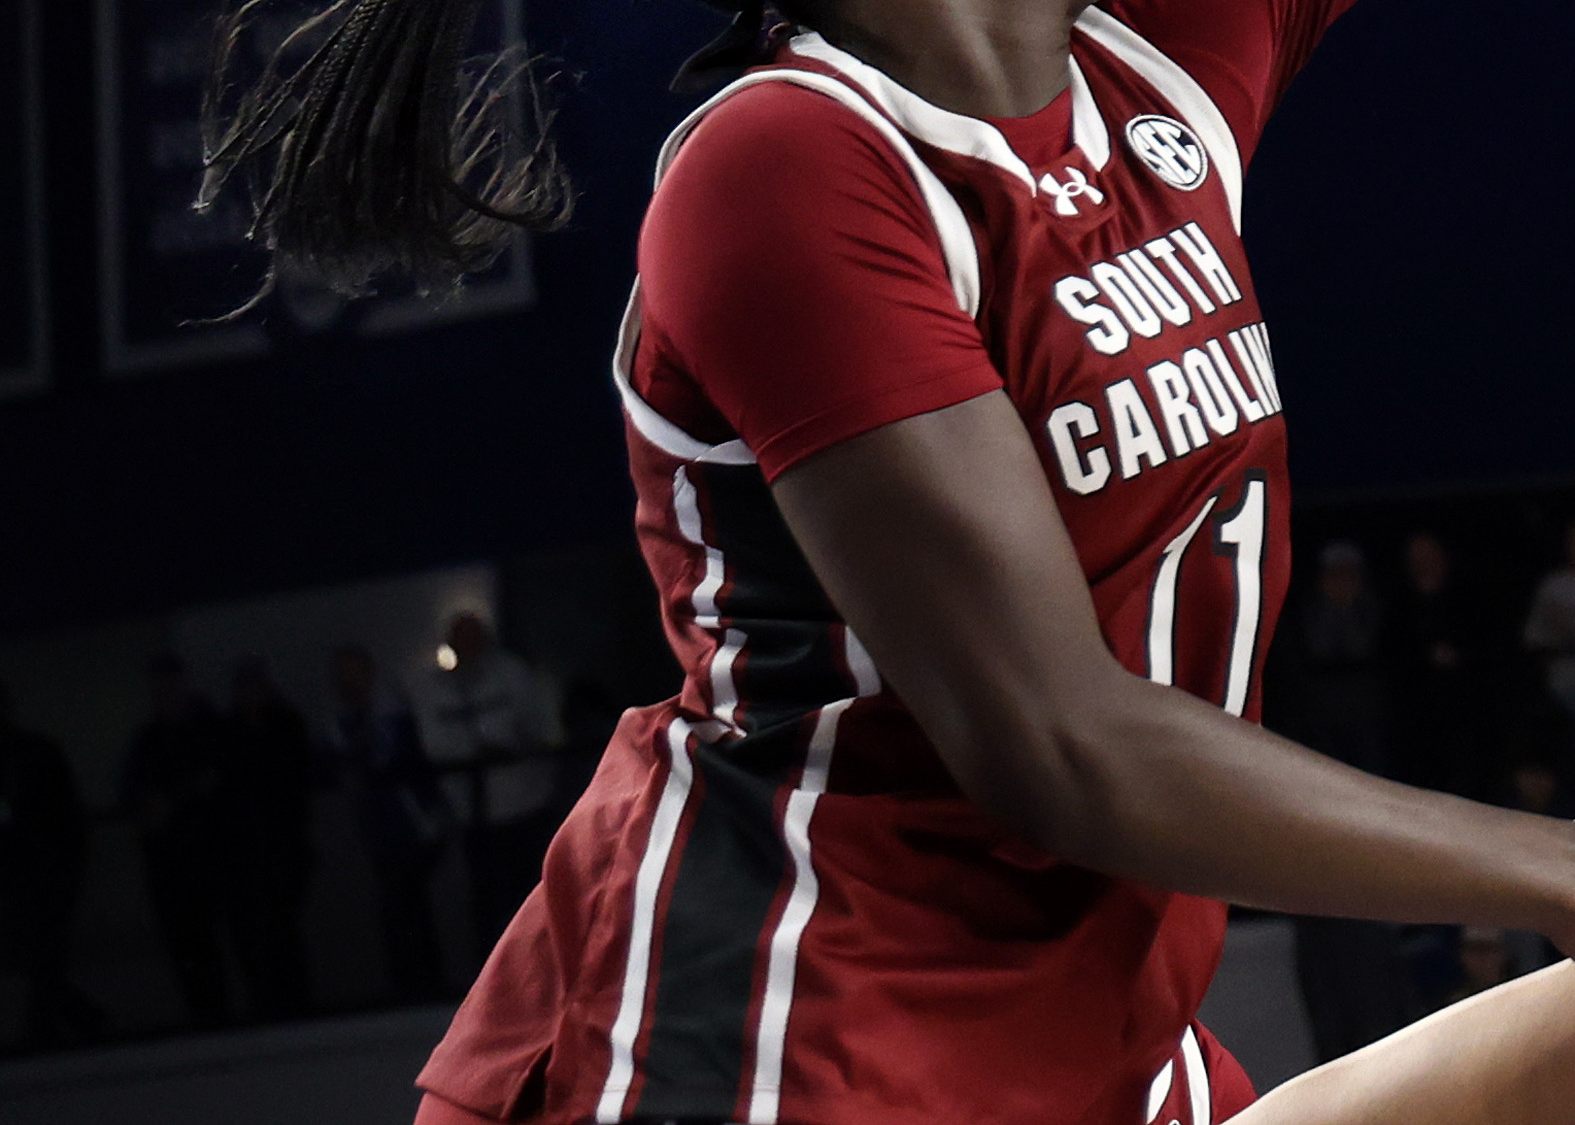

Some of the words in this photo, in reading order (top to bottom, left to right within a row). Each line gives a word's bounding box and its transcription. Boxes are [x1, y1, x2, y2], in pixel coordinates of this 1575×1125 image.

[1130, 119, 1203, 187] SEC
[1053, 219, 1243, 356] SOUTH
[1046, 321, 1283, 496] CAROLIN
[1146, 476, 1268, 719] 11
